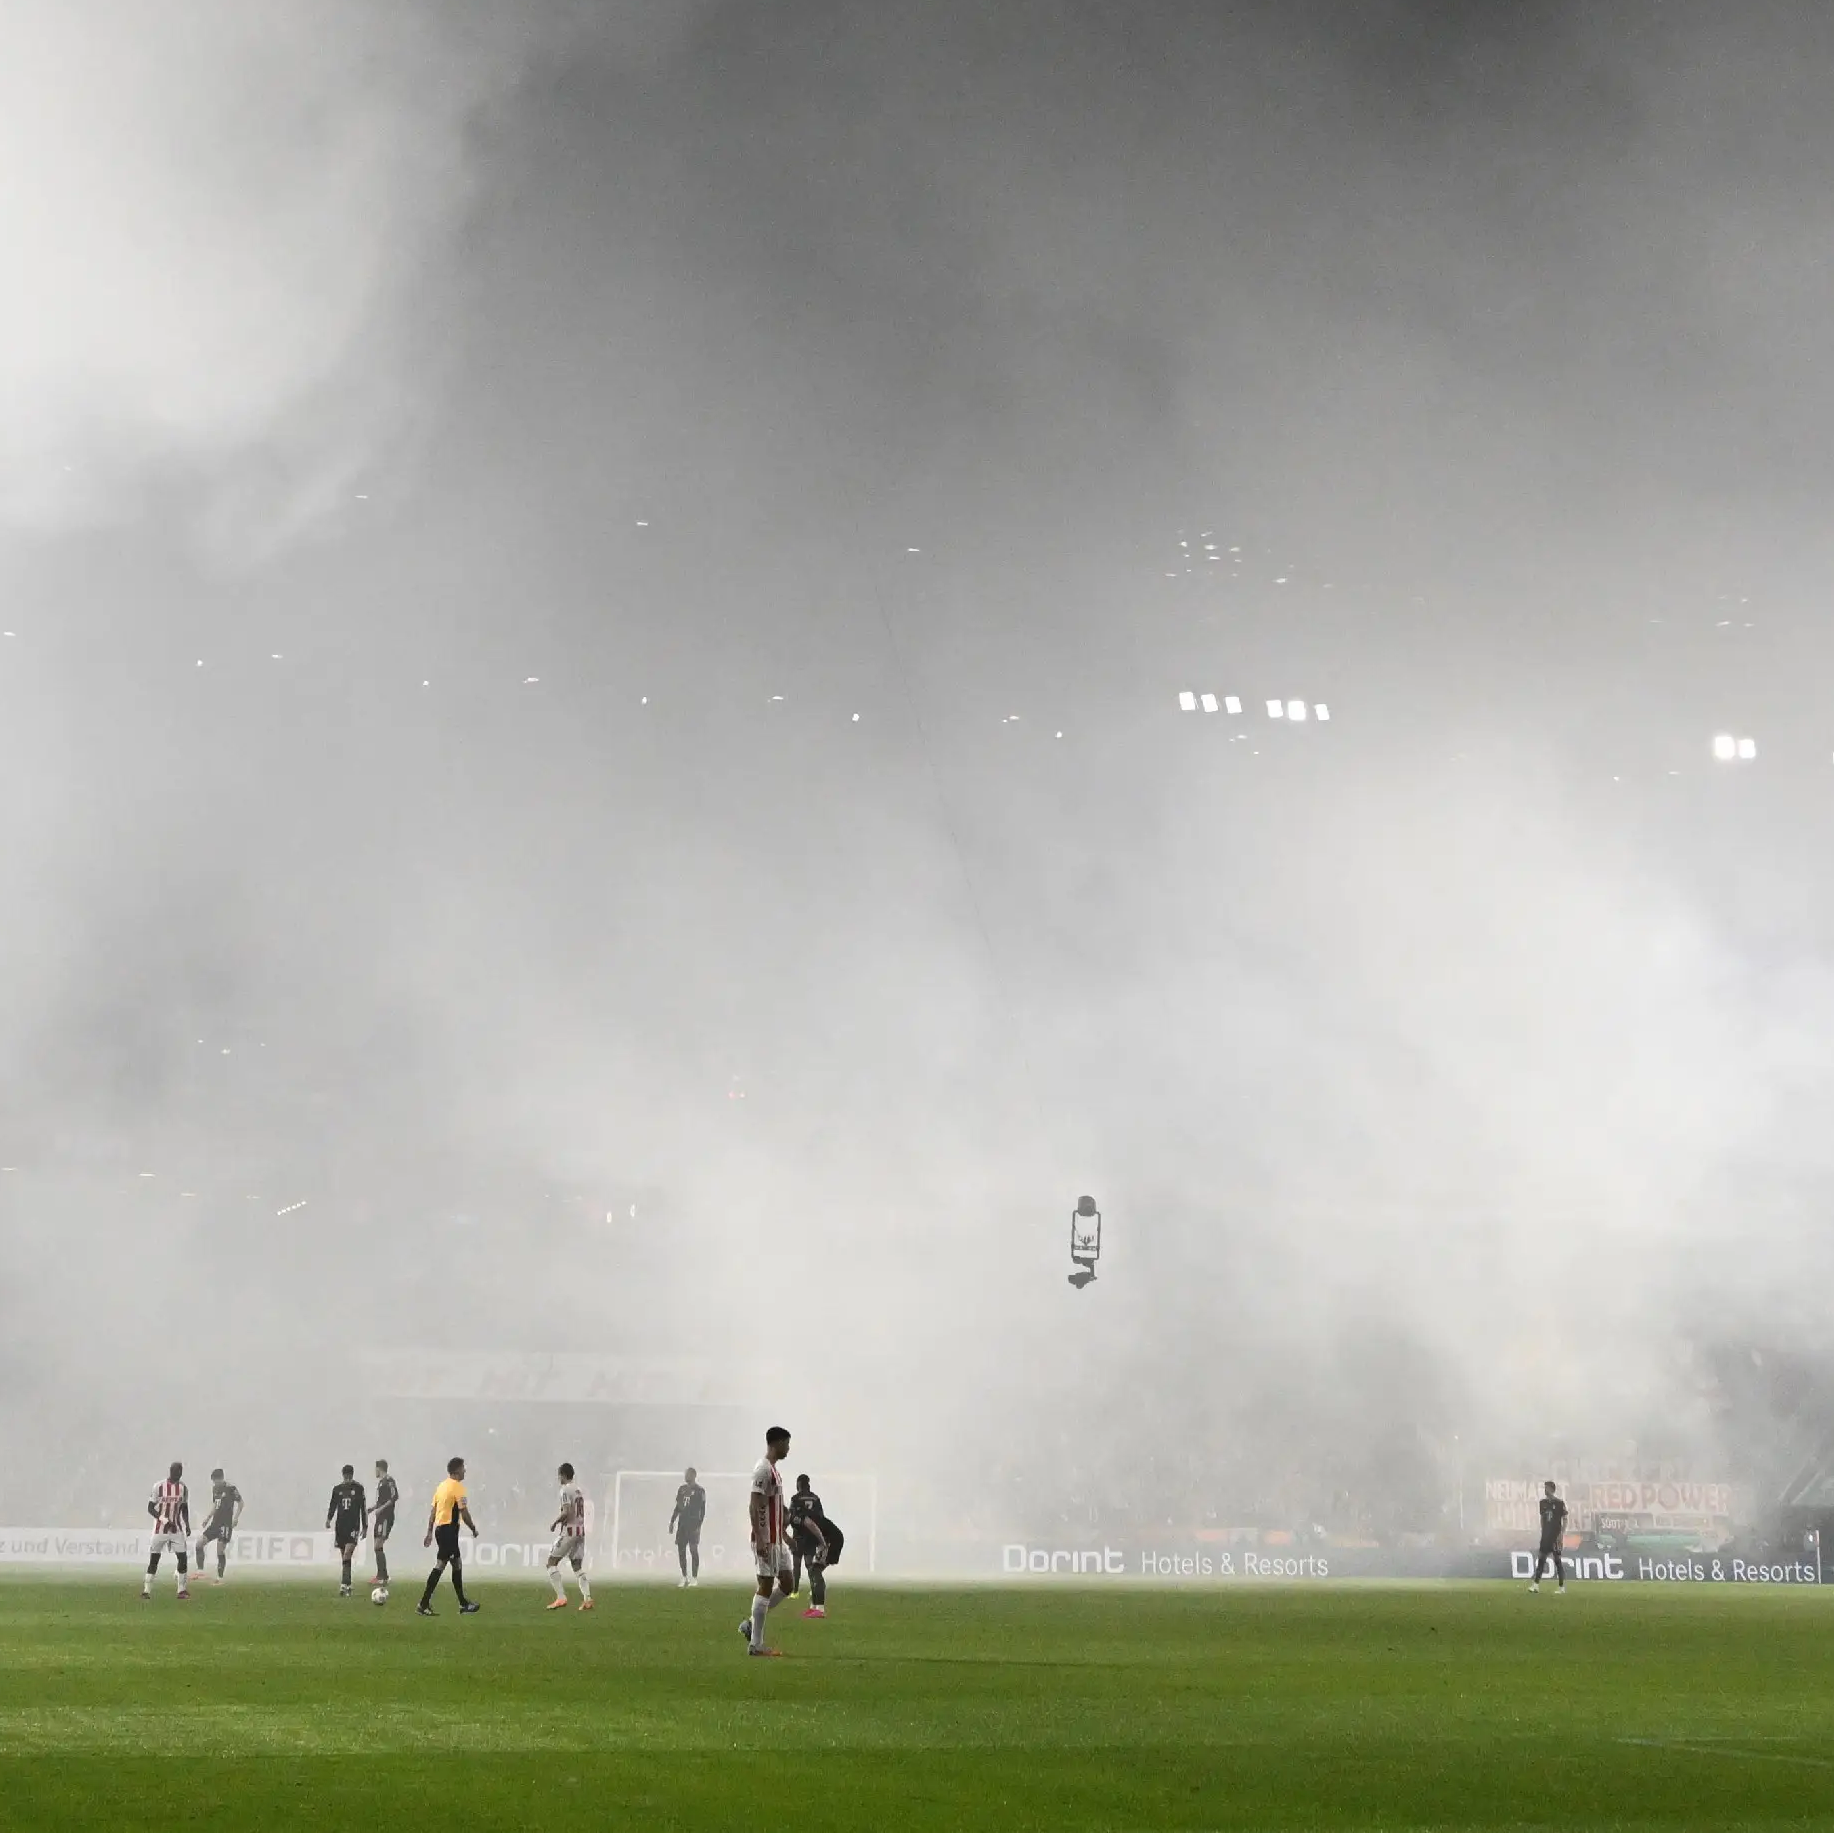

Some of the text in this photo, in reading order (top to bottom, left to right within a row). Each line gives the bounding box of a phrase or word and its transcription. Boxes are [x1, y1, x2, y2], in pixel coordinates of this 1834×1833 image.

[11, 1537, 48, 1555] und
[1003, 1545, 1328, 1576] Dorint Hotels & Resorts
[1639, 1558, 1704, 1581] Hotels
[1711, 1560, 1726, 1581] &
[1733, 1559, 1814, 1583] Resorts
